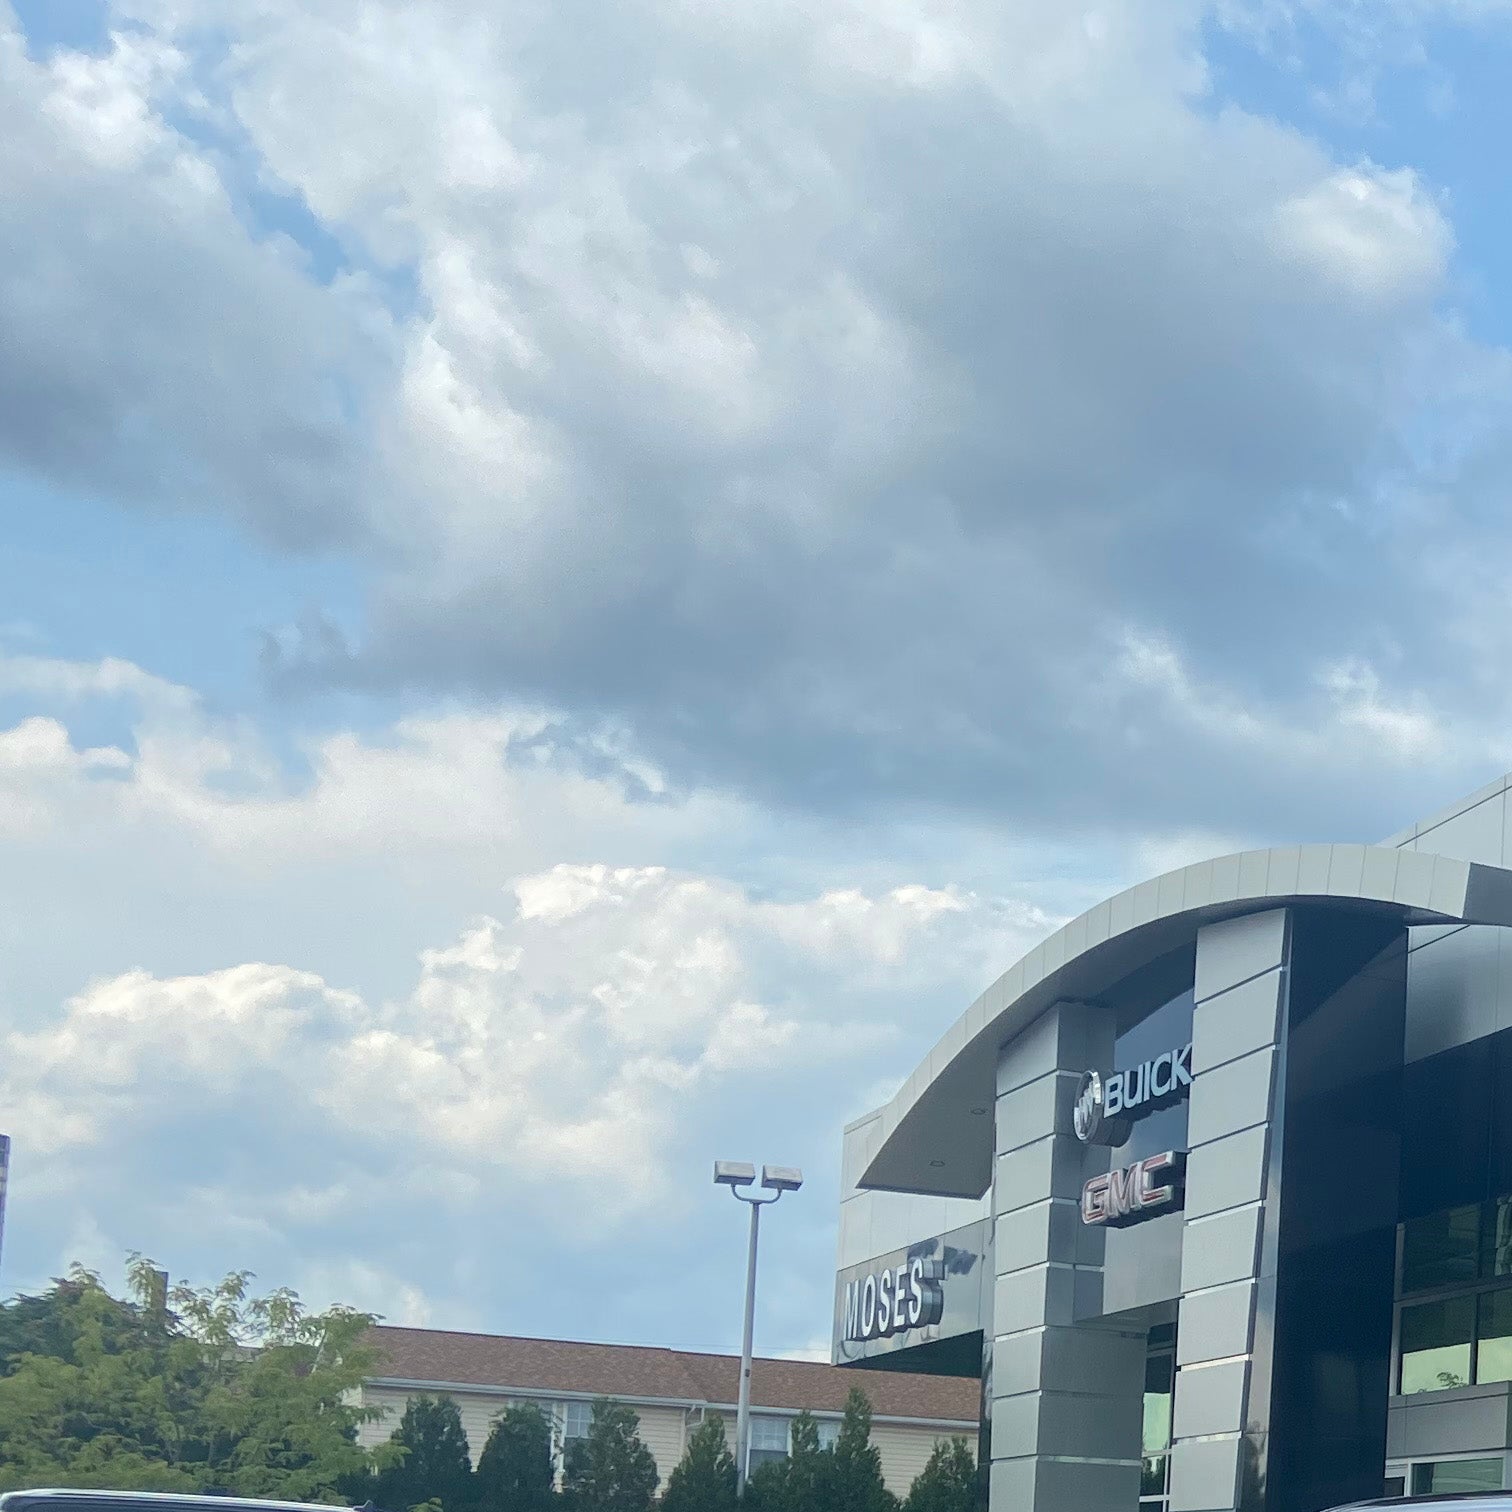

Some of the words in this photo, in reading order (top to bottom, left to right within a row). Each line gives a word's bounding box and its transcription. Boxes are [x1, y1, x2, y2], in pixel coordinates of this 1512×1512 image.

[1103, 1042, 1194, 1119] BUICK
[1081, 1150, 1176, 1225] GMC
[843, 1258, 923, 1341] MOSES
